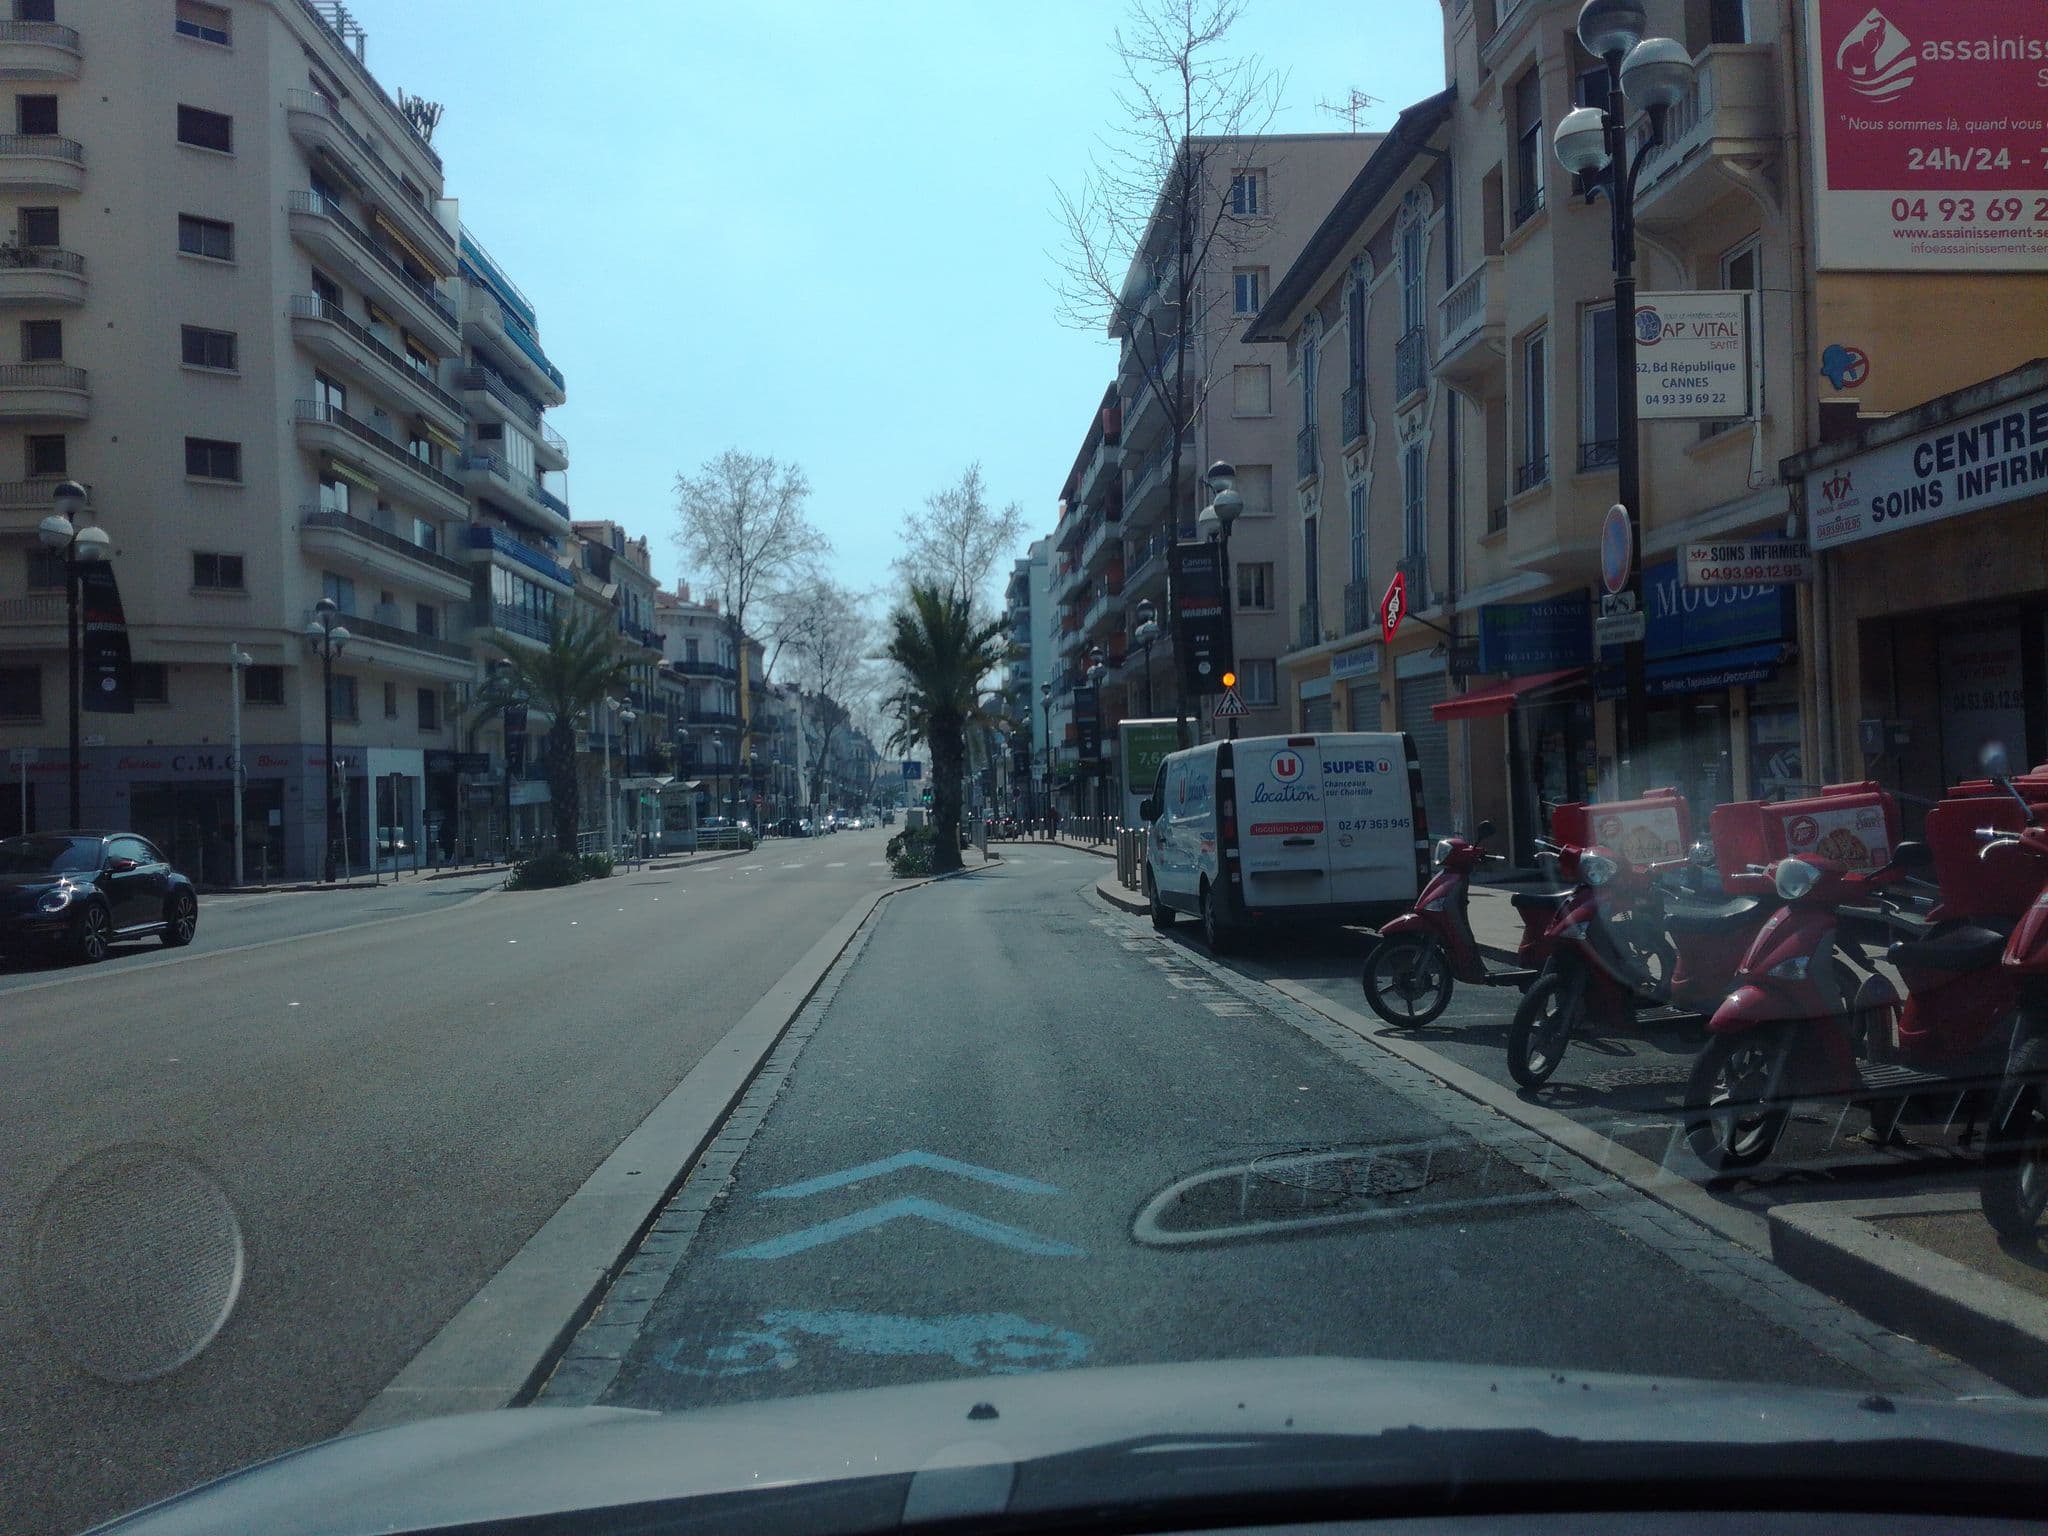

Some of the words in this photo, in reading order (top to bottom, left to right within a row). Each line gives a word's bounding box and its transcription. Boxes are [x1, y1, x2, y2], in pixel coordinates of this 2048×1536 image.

[1887, 120, 1943, 130] sommes
[1946, 117, 1960, 131] là,
[1965, 117, 2007, 133] quand
[2011, 120, 2042, 130] vous
[1908, 147, 2011, 171] 24h/24
[1891, 198, 1928, 222] 04
[1938, 198, 1975, 222] 93
[1986, 197, 2023, 222] 69
[1692, 322, 1738, 337] VITAL
[1653, 362, 1668, 372] Bd
[1671, 361, 1736, 373] République
[1661, 377, 1709, 389] CANNES
[1645, 394, 1660, 404] 04
[1662, 394, 1676, 404] 93
[1679, 394, 1692, 403] 39
[1695, 393, 1709, 403] 69
[1712, 393, 1726, 402] 22
[1914, 404, 2048, 478] CENTRE
[1872, 480, 1943, 523] SOINS
[1711, 546, 1745, 562] SOINS
[1701, 565, 1803, 580] 04.93.99.12.95
[1277, 759, 1296, 776] U
[1323, 761, 1375, 774] SUPER
[1251, 782, 1320, 804] location
[1338, 821, 1351, 831] 02
[1354, 820, 1367, 830] 47
[1370, 820, 1388, 829] 363
[1391, 819, 1410, 828] 945
